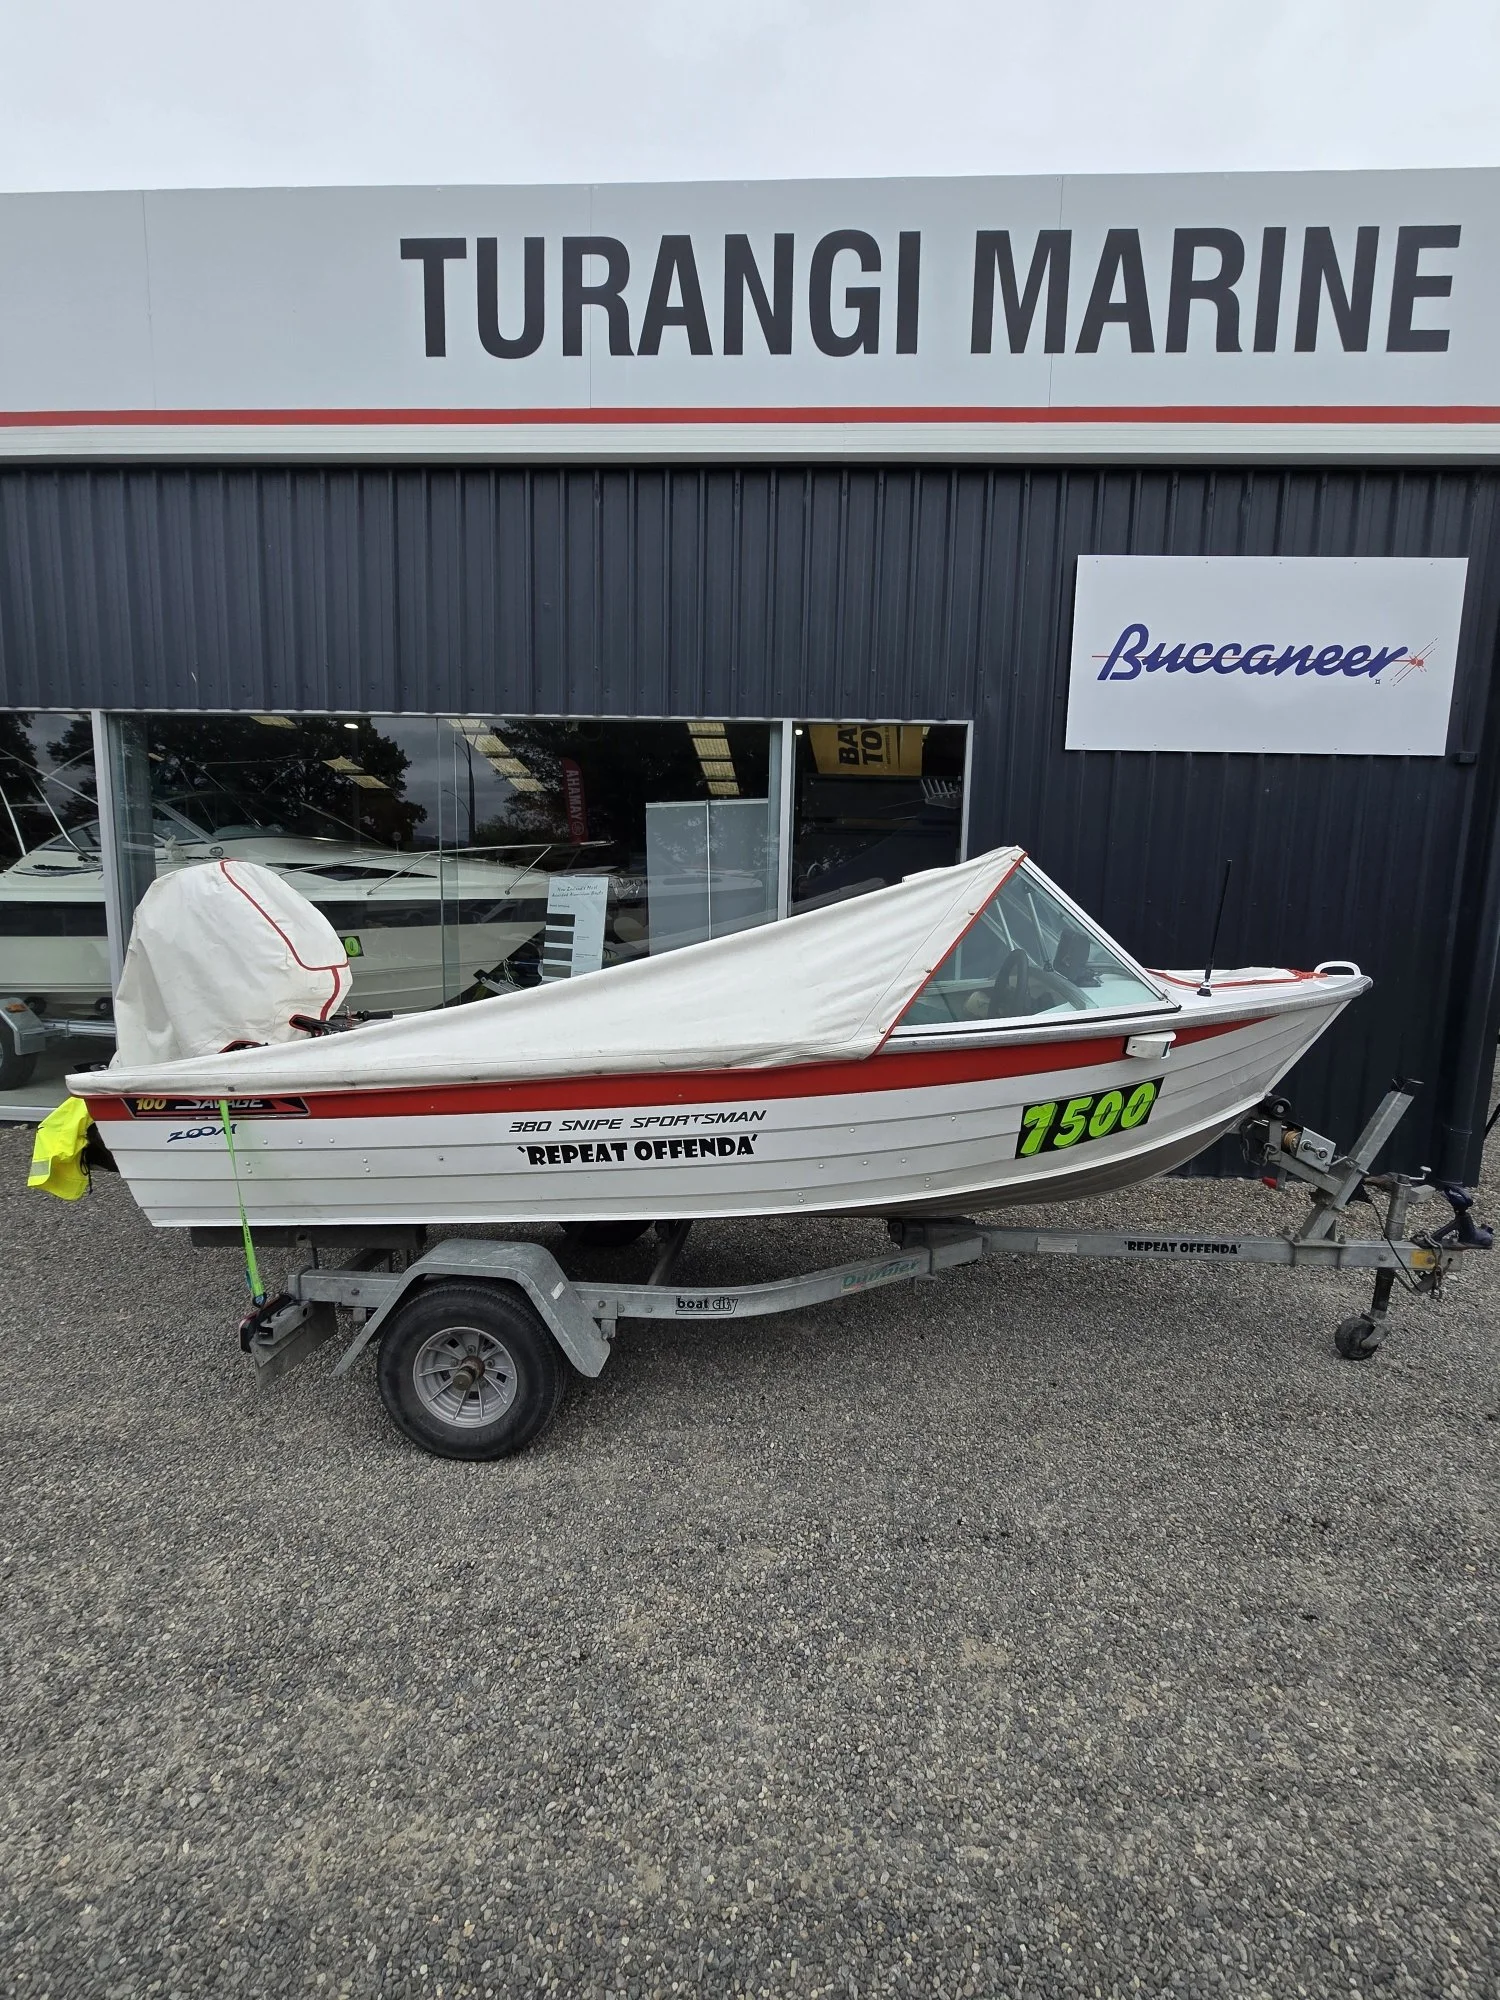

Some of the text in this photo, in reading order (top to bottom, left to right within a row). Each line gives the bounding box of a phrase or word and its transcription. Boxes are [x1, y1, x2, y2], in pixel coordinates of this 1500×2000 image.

[400, 225, 1462, 359] TURANGI MARINE
[1096, 623, 1408, 681] Buccaneer
[837, 724, 860, 766] BA
[860, 724, 883, 766] TO
[135, 1097, 167, 1110] 100
[509, 1109, 768, 1133] 380 SNIPE SPORTSMAN
[1020, 1082, 1157, 1156] 7500
[676, 1296, 739, 1314] boat city
